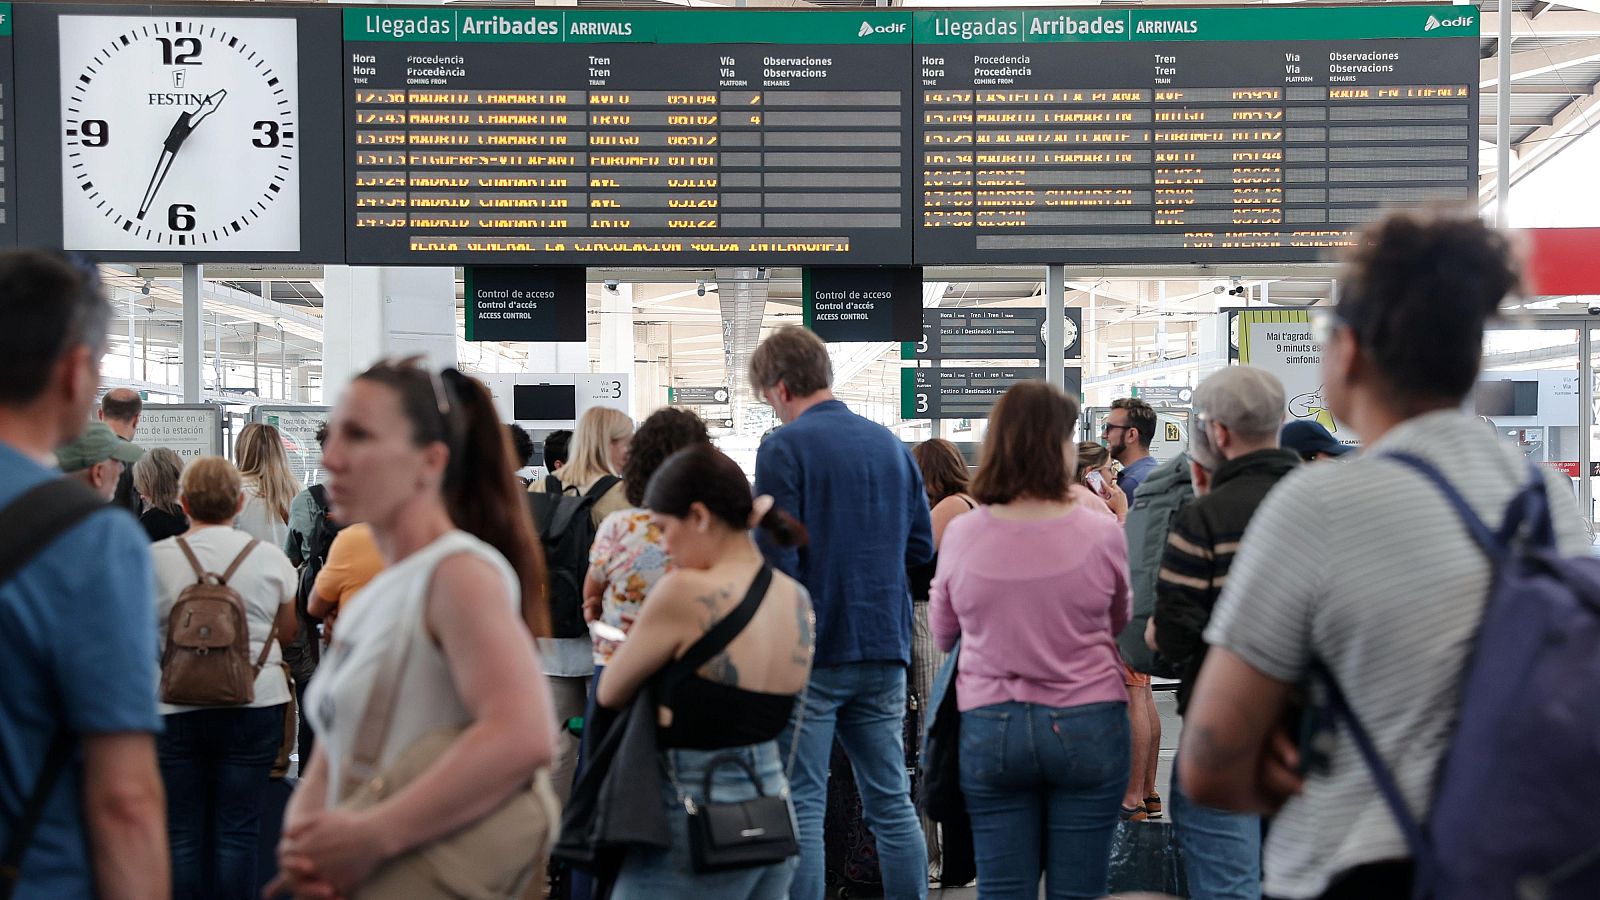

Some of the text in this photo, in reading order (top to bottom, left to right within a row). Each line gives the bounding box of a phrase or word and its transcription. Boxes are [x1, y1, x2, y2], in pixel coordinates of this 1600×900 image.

[1442, 17, 1473, 26] adif
[367, 16, 631, 37] Llegadas Arribades ARRIVALS
[875, 23, 906, 33] adif
[936, 16, 1197, 39] Llegadas Arribades ARRIVALS
[155, 37, 204, 66] 12
[1330, 52, 1398, 60] Observaciones
[353, 54, 375, 62] Hora
[408, 56, 463, 64] Procedencia
[589, 56, 610, 64] Tren
[720, 57, 734, 65] Vía
[764, 57, 831, 65] Observaciones
[923, 57, 944, 65] Hora
[975, 55, 1030, 64] Procedencia
[1155, 55, 1175, 63] Tren
[354, 66, 375, 74] Hora
[589, 68, 610, 76] Tren
[923, 68, 944, 76] Hora
[975, 67, 1031, 76] Procedència
[1155, 67, 1175, 75] Tren
[1330, 63, 1393, 72] Observacions
[764, 68, 826, 77] Observacions
[148, 93, 213, 106] FESTINA
[81, 120, 108, 147] 9
[252, 121, 279, 148] 3
[168, 204, 195, 231] 6
[478, 290, 508, 298] Control
[512, 290, 522, 298] de
[816, 291, 845, 299] Control
[849, 291, 860, 299] de
[846, 301, 874, 309] d'accés
[1277, 344, 1325, 353] 9 minuts es
[1286, 355, 1320, 364] simfonia
[611, 380, 622, 399] 3
[916, 393, 929, 413] 3
[161, 414, 185, 423] fumar
[199, 414, 205, 422] el
[151, 427, 161, 435] de
[172, 426, 204, 434] estación
[194, 448, 201, 456] el
